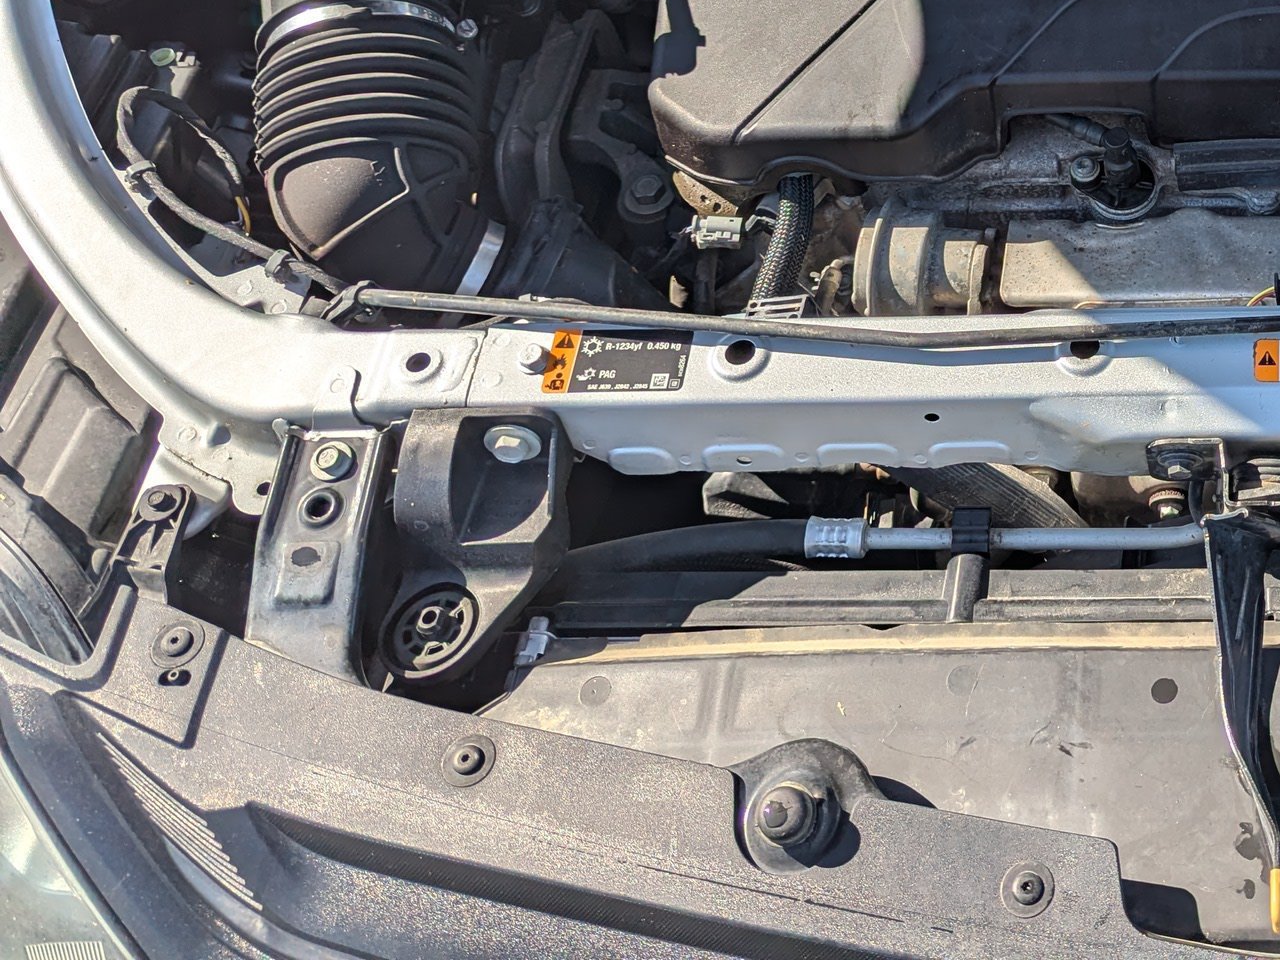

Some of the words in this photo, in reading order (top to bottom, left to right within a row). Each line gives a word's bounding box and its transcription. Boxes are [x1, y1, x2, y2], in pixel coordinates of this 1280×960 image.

[605, 342, 643, 352] R-1234yf
[646, 342, 670, 350] 0.450
[670, 342, 682, 351] kg
[598, 370, 616, 379] PAG
